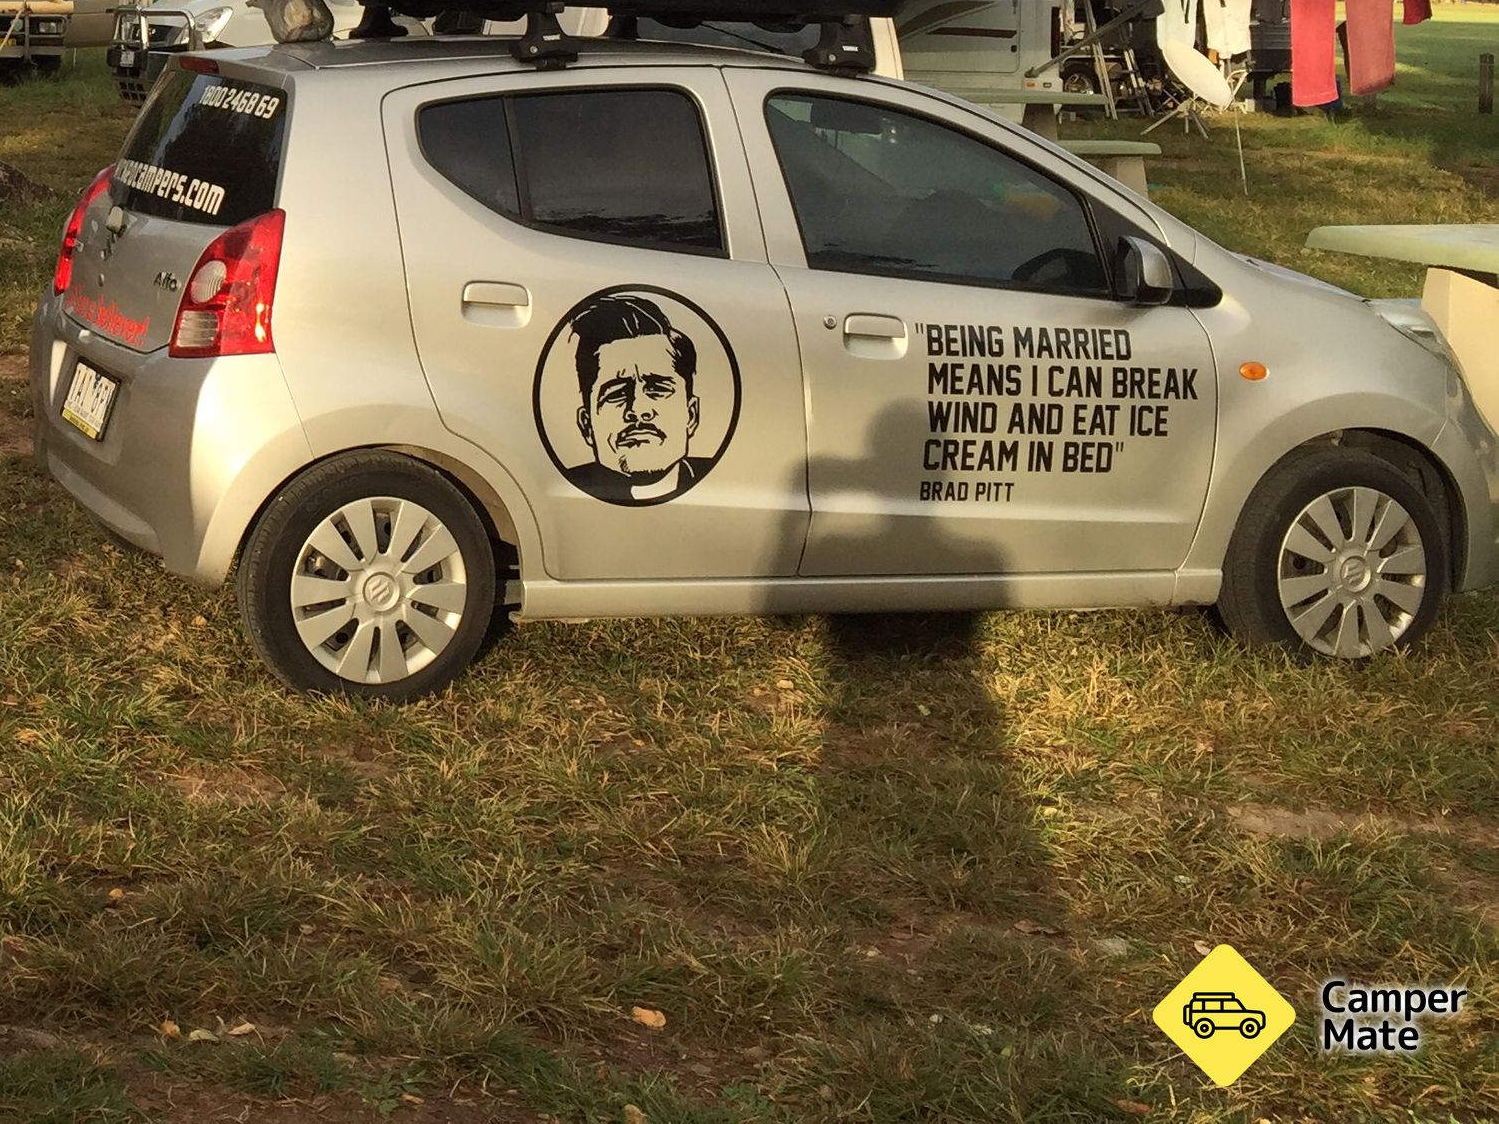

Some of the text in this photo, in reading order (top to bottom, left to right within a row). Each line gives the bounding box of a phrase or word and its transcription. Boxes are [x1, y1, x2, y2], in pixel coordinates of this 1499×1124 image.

[914, 322, 1133, 361] "BEING MARRIED
[927, 362, 1199, 401] MEANS I CAN BREAK
[927, 400, 1170, 437] WIND AND EAT ICE
[922, 438, 1125, 474] CREAM IN BED"
[919, 480, 1015, 503] BRAD PITT
